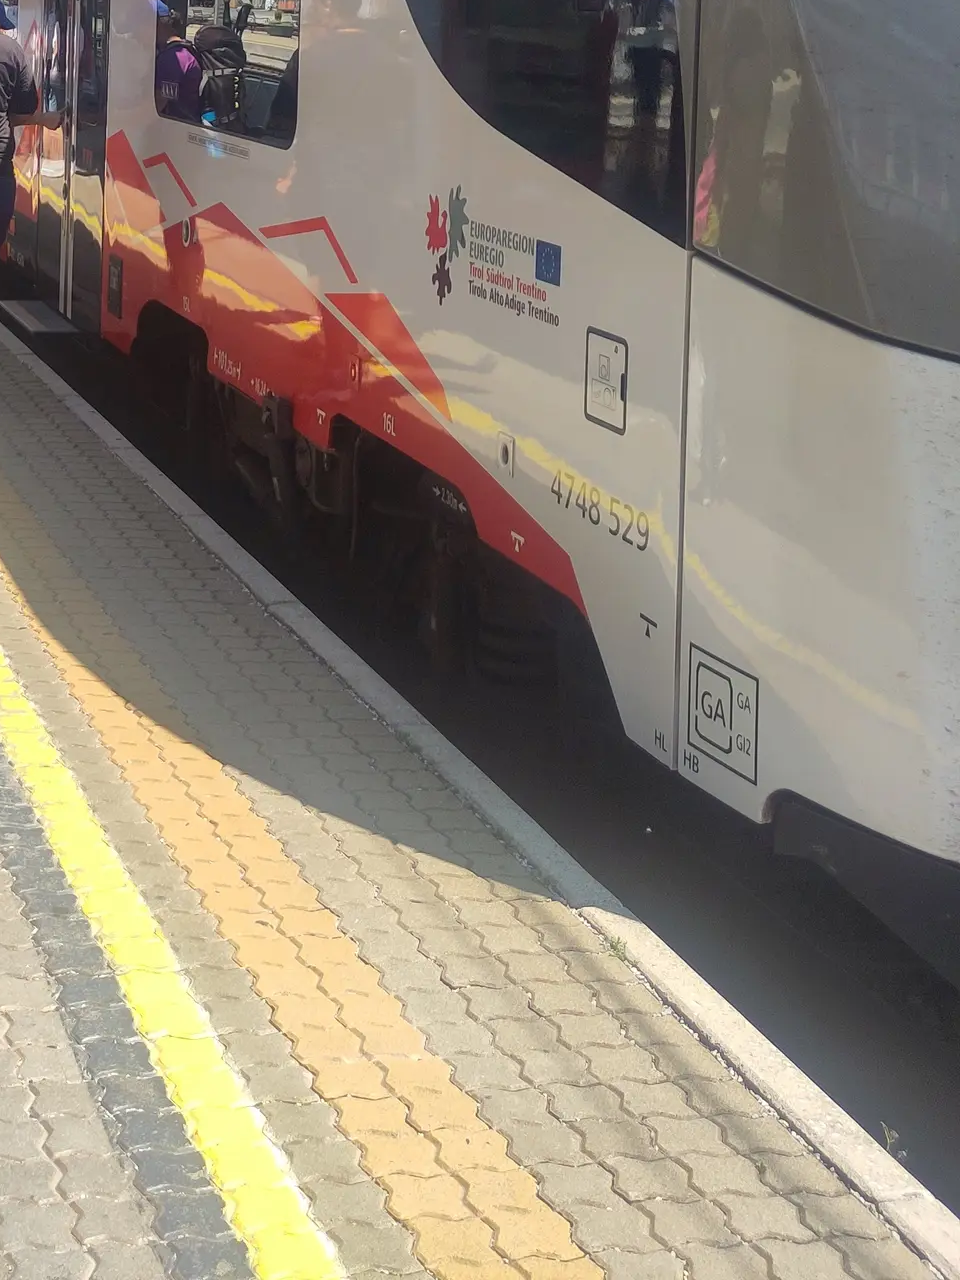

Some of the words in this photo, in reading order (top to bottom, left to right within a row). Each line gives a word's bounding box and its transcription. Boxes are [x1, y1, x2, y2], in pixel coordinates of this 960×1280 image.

[470, 220, 535, 256] EUROPAREGION
[469, 241, 505, 269] EUREGIO
[469, 261, 484, 281] Tirol
[486, 267, 514, 291] Südtirol
[516, 277, 547, 302] Trentino
[468, 280, 487, 300] Tirolo
[489, 287, 504, 307] Alto
[504, 293, 526, 317] Adige
[527, 300, 560, 327] Trentino
[382, 411, 396, 437] 16L
[550, 469, 601, 526] 4748
[608, 496, 650, 552] 529
[701, 690, 727, 728] GA
[736, 692, 752, 714] GA
[654, 728, 668, 753] HL
[683, 749, 700, 774] HB
